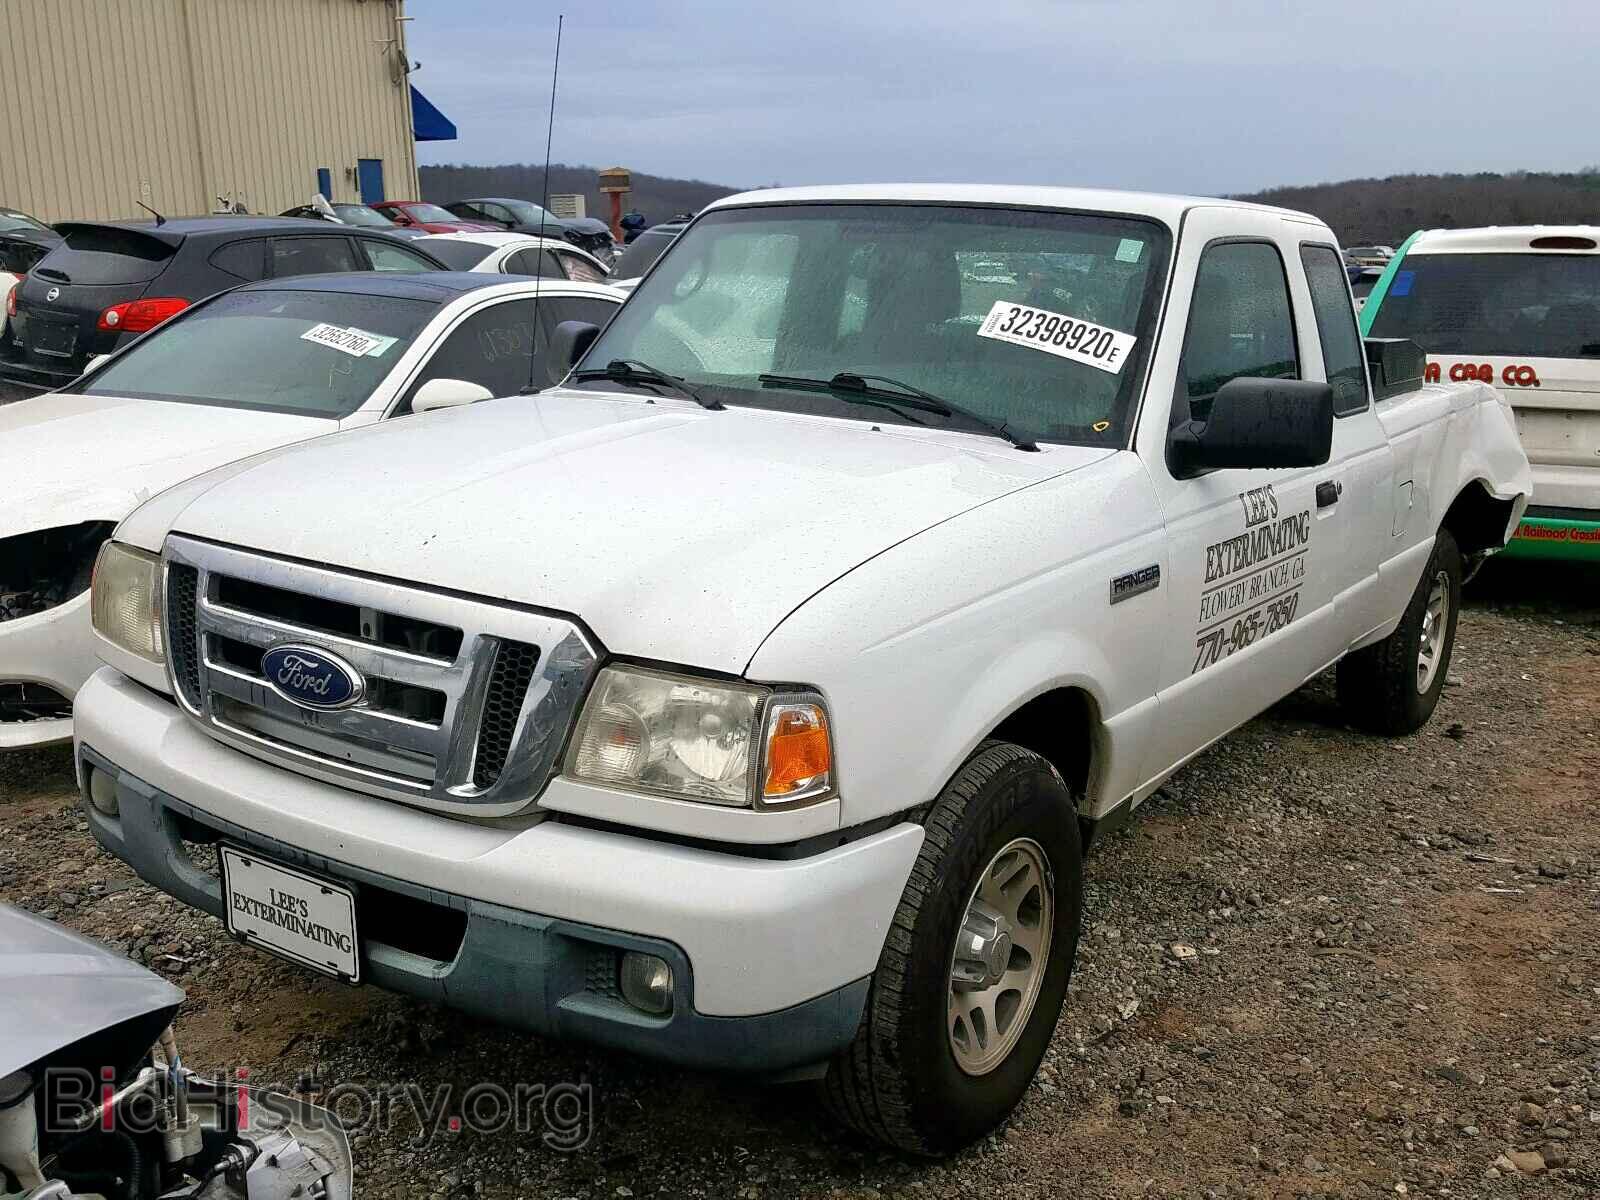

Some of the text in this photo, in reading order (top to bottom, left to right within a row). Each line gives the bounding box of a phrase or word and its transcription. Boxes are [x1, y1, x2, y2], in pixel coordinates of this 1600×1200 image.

[1449, 362, 1494, 384] CAB
[1502, 365, 1541, 387] CO.
[1239, 484, 1279, 528] LEE'S
[1204, 510, 1310, 584] EXTERMINATING
[1523, 524, 1568, 538] Railroad
[1113, 564, 1161, 594] RANGER
[1199, 587, 1247, 623] FLOWERY
[1249, 565, 1290, 601] BRANCH,
[1192, 592, 1299, 675] 770-965-7850
[278, 655, 333, 695] Ford
[232, 891, 352, 954] EXTERMINATING
[269, 887, 309, 918] LEE'S
